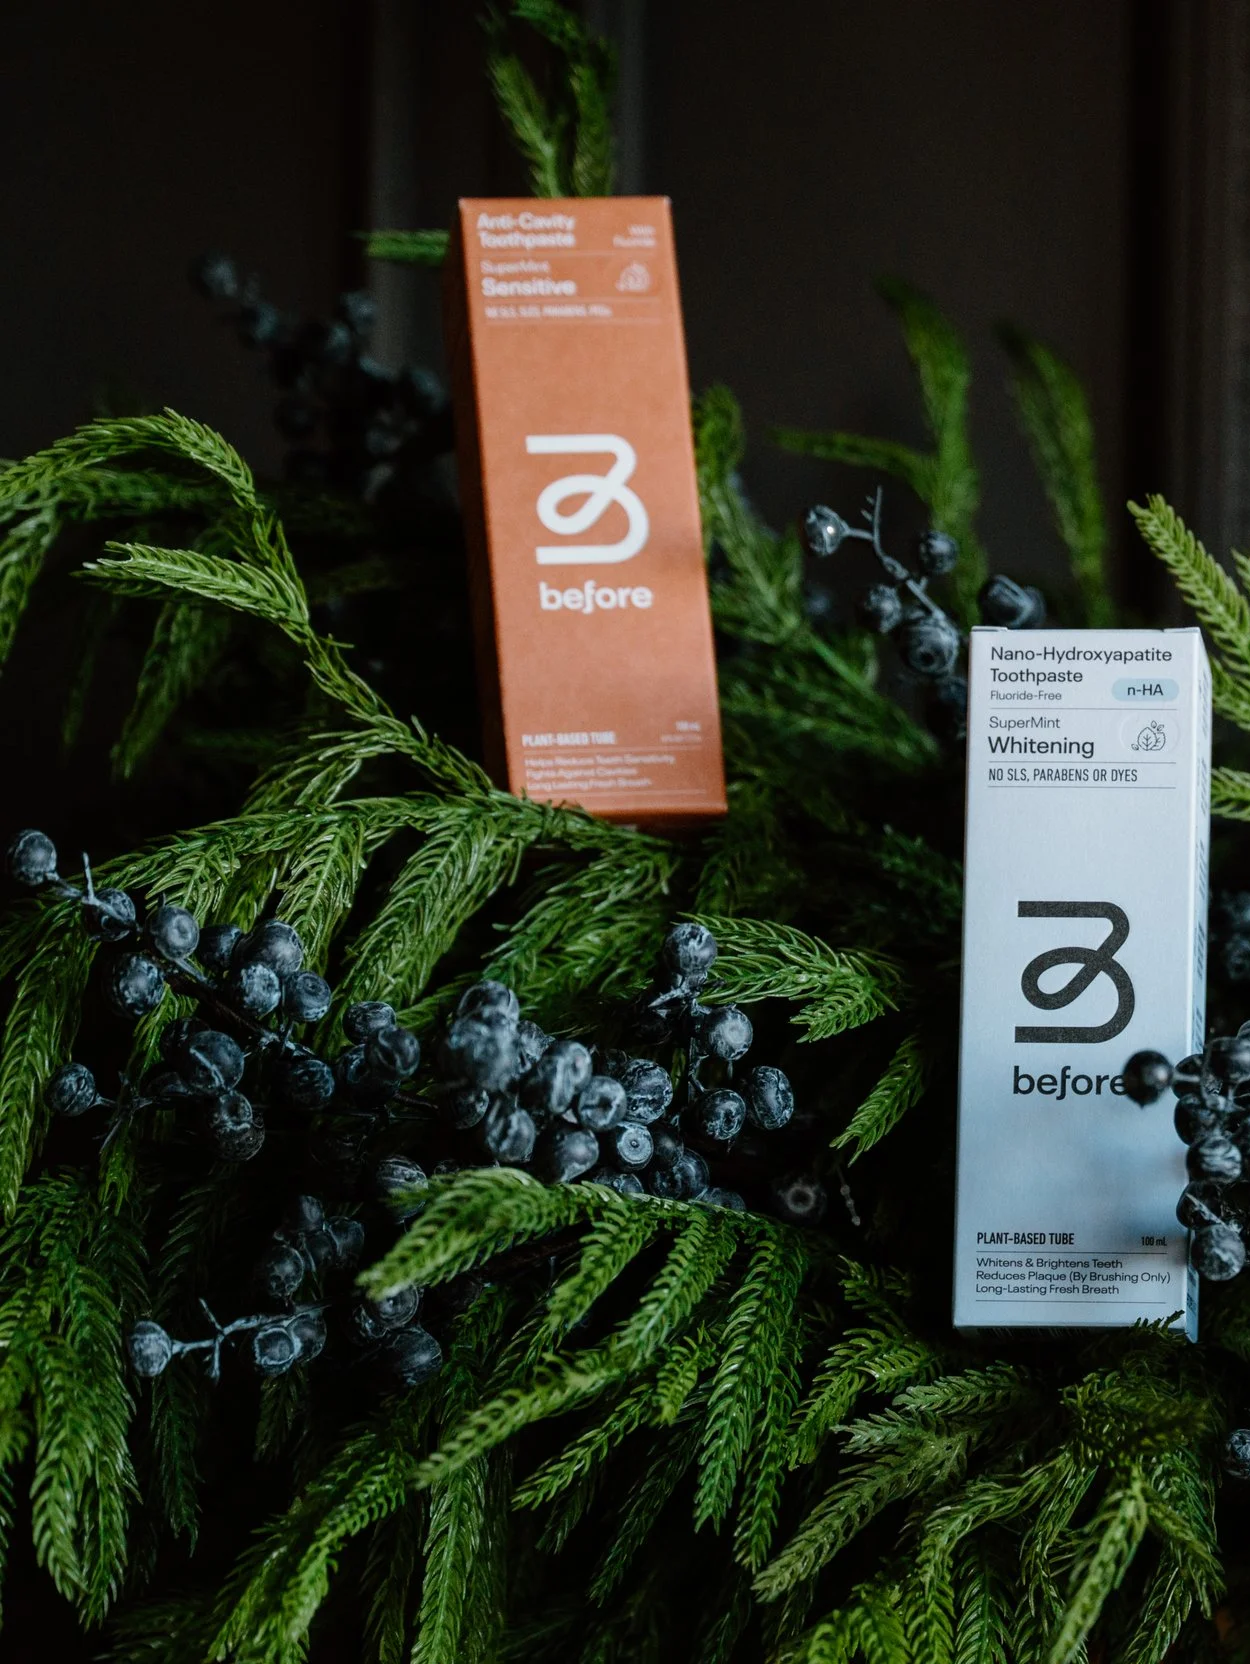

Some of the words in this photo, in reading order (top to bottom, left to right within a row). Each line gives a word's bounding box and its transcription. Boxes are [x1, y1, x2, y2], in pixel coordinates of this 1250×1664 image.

[477, 212, 575, 230] Anti-Cavity
[479, 231, 575, 250] Toothpaste
[481, 277, 577, 296] Sensitive
[539, 580, 654, 614] before
[990, 645, 1173, 665] Nano-Hydroxyapatite
[990, 668, 1084, 686] Toothpaste
[989, 690, 1063, 702] Fluoride-Free
[1126, 683, 1164, 697] n-HA
[988, 715, 1061, 732] SuperMint
[522, 733, 589, 747] PLANT-BASED
[987, 736, 1096, 760] Whitening
[988, 768, 1004, 782] NO
[1007, 768, 1030, 782] SLS,
[1033, 768, 1090, 782] PARABENS
[1092, 769, 1107, 782] OR
[1110, 769, 1138, 782] DYES
[1013, 1065, 1128, 1100] before
[976, 1232, 1046, 1245] PLANT-BASED
[1048, 1232, 1075, 1245] TUBE
[1140, 1236, 1154, 1247] 100
[1155, 1236, 1167, 1247] mL
[976, 1257, 1023, 1268] Whitens
[1025, 1258, 1034, 1268] &
[1036, 1257, 1090, 1270] Brightens
[1091, 1258, 1123, 1269] Teeth
[976, 1270, 1026, 1281] Reduces
[1027, 1270, 1067, 1283] Plaque
[1069, 1271, 1086, 1284] (By
[1089, 1271, 1139, 1284] Brushing
[1140, 1271, 1171, 1284] Only)
[975, 1284, 1047, 1295] Long-Lasting
[1049, 1284, 1080, 1294] Fresh
[1081, 1284, 1120, 1295] Breath
